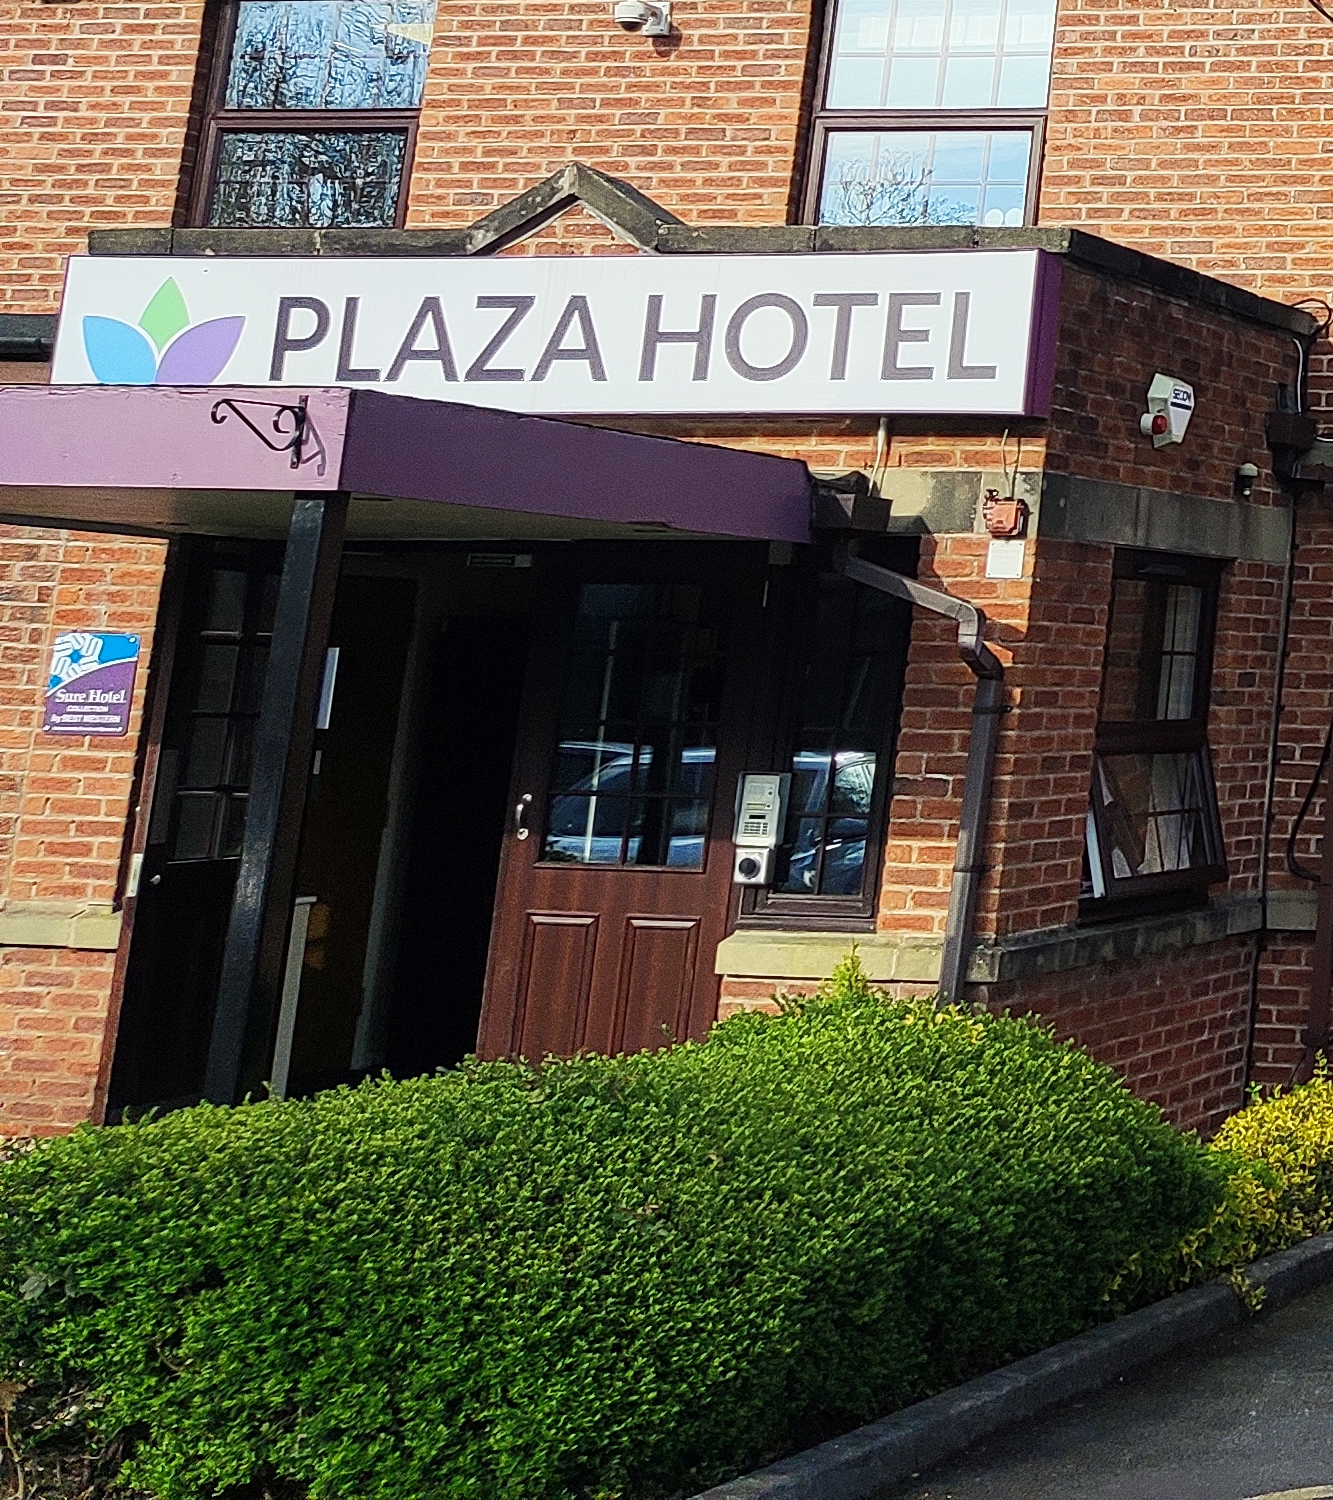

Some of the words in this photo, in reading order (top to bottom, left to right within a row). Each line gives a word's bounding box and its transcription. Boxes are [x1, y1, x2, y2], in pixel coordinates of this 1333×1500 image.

[268, 295, 608, 383] PLAZA
[638, 291, 997, 382] HOTEL
[55, 688, 86, 703] Sure
[87, 689, 127, 704] Hotel
